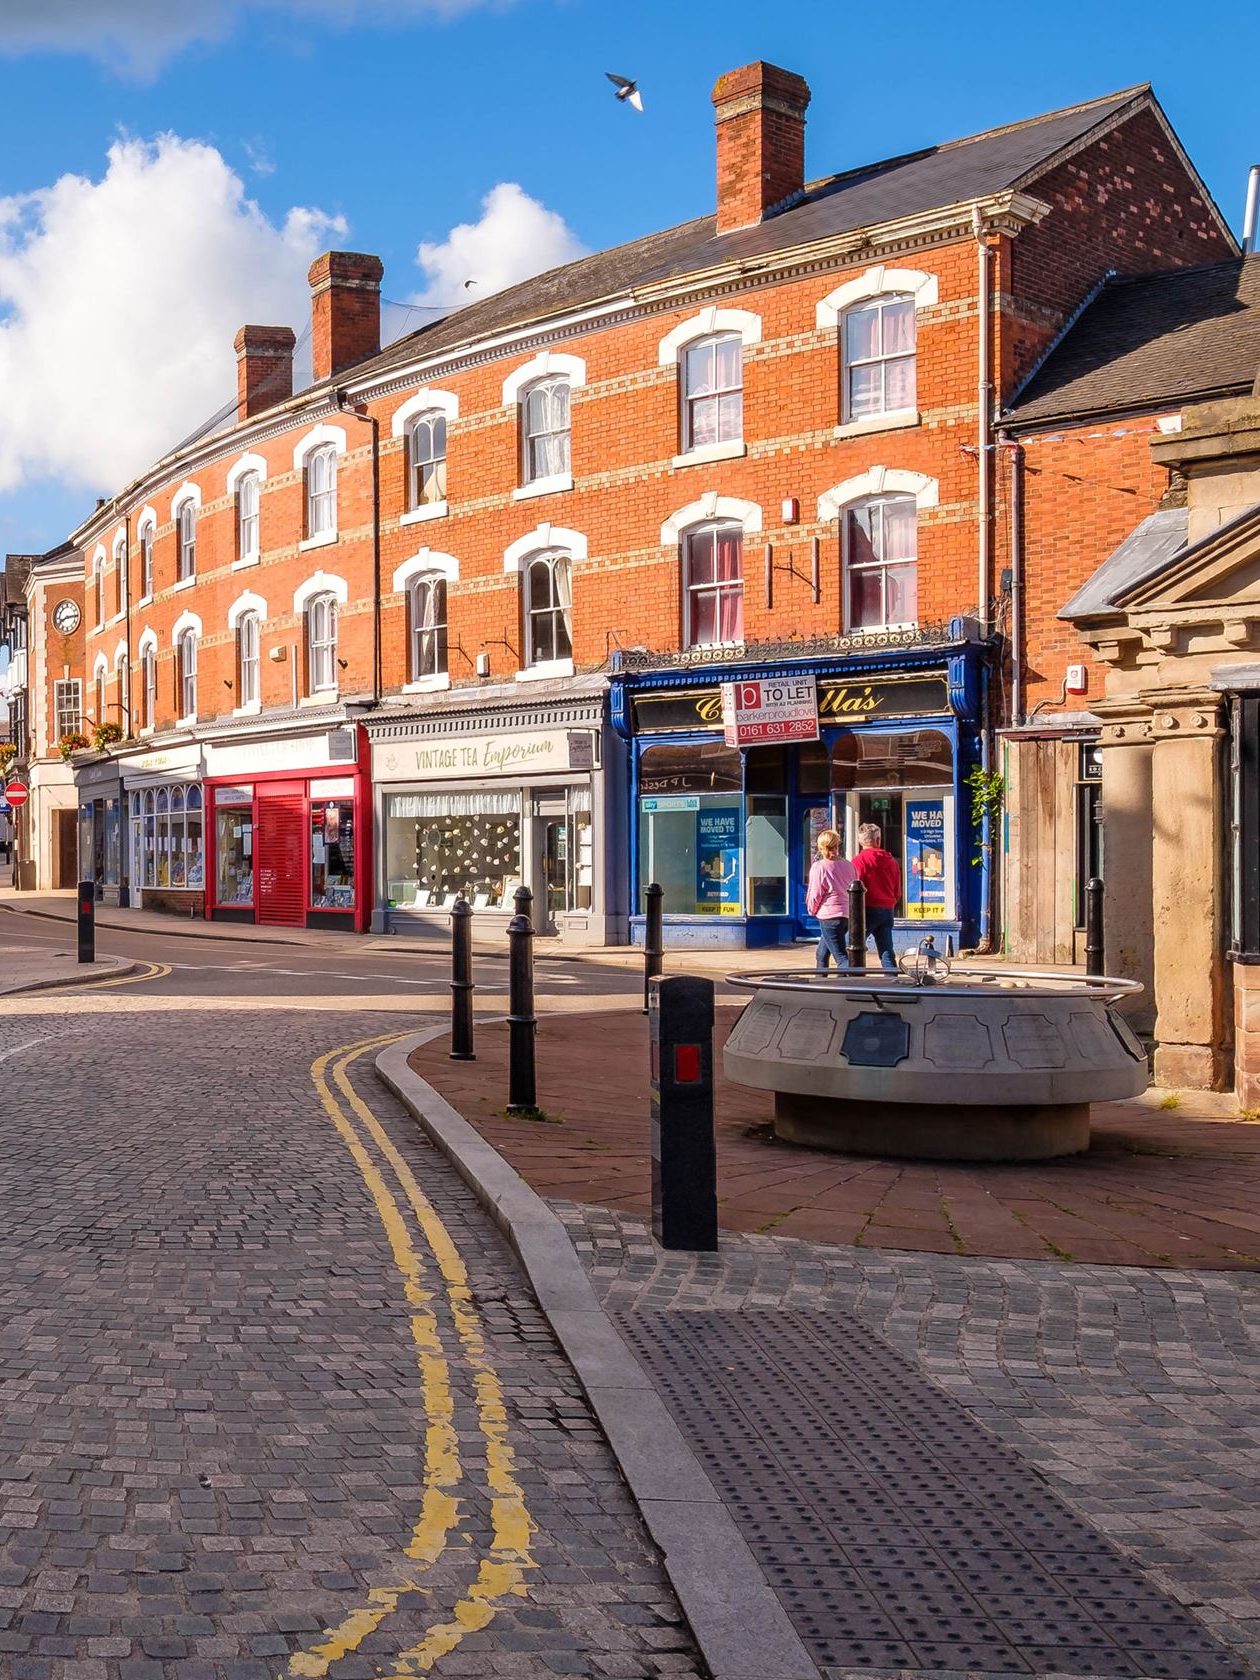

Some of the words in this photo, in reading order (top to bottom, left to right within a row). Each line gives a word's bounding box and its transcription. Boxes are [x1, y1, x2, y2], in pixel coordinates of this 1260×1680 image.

[768, 680, 790, 688] RETAIL
[764, 688, 783, 702] TO
[788, 686, 814, 699] LET
[736, 707, 817, 722] barkerproudlove
[740, 725, 763, 737] 0161
[767, 723, 785, 734] 631
[789, 720, 815, 732] 2852
[415, 749, 458, 770] VINTAGE
[460, 746, 478, 767] TEA
[483, 739, 555, 771] Emporium
[911, 811, 928, 820] WE
[930, 811, 945, 820] HA
[700, 818, 713, 826] WE
[715, 817, 735, 826] HAVE
[911, 820, 942, 828] MOVED
[700, 826, 724, 834] MOVED
[725, 825, 735, 833] TO
[702, 904, 715, 913] KEEP
[716, 904, 722, 912] IT
[723, 903, 735, 912] FUN
[913, 906, 931, 914] KEEP
